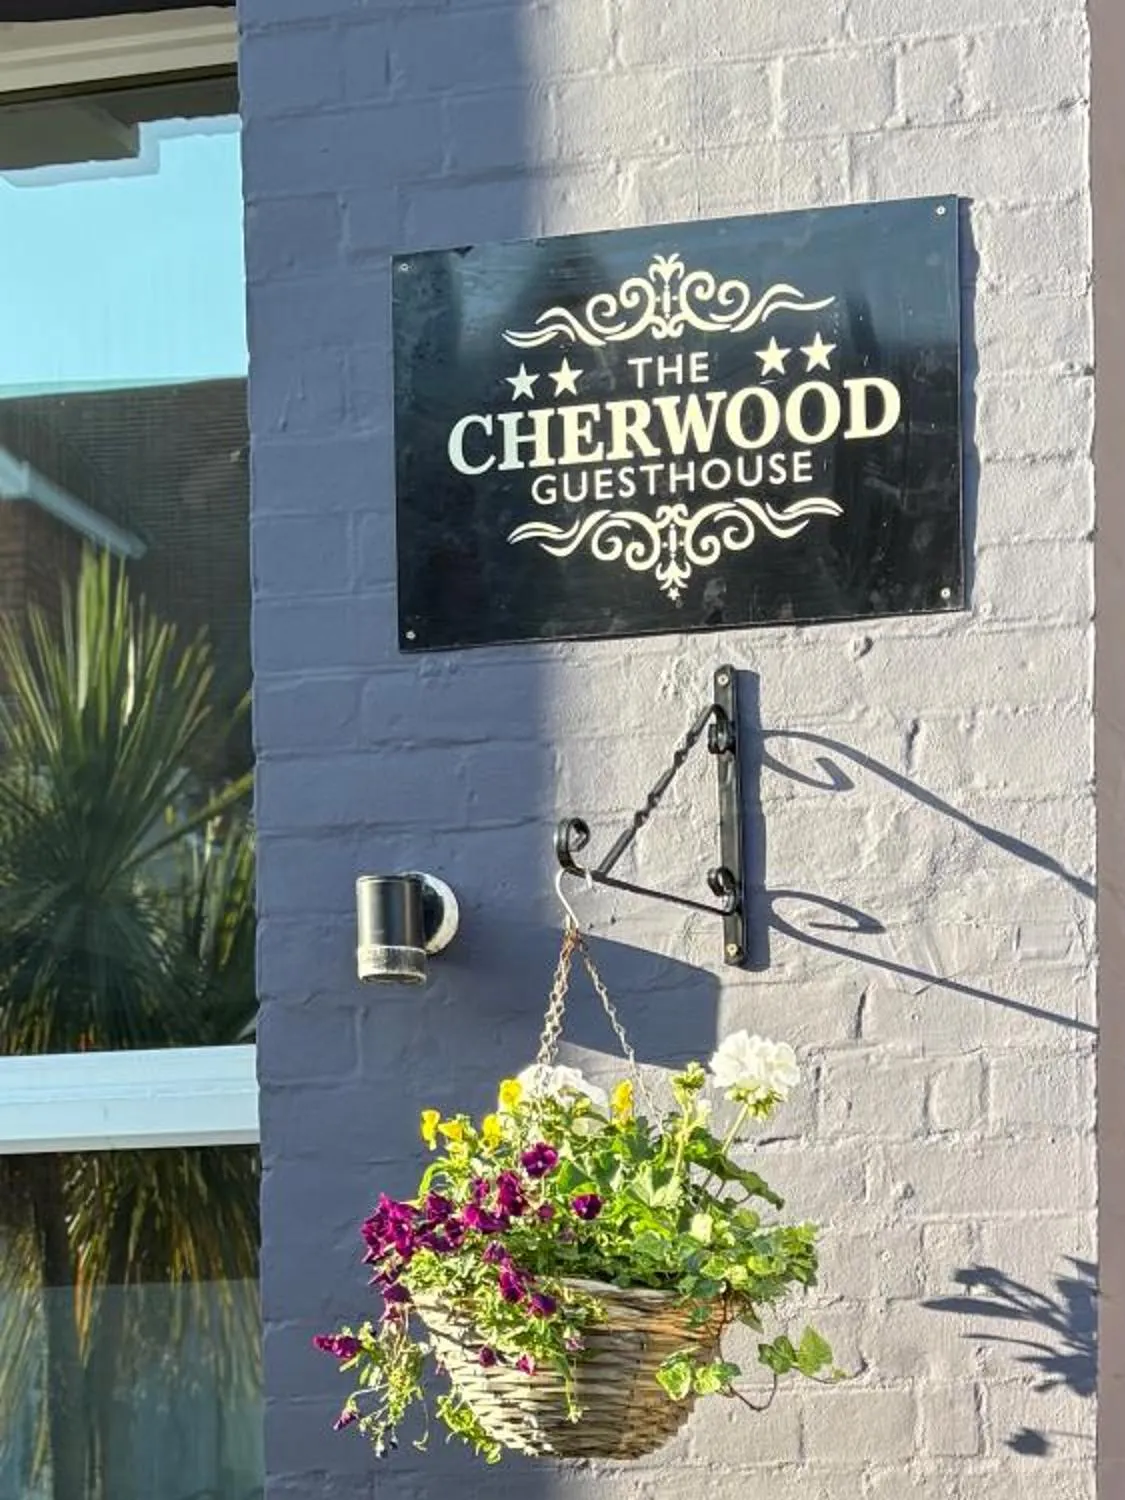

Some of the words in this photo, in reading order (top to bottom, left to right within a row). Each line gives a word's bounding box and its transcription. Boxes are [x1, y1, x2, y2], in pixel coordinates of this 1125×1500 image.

[628, 351, 710, 389] THE
[447, 376, 902, 475] CHERWOOD
[531, 450, 813, 505] GUESTHOUSE
